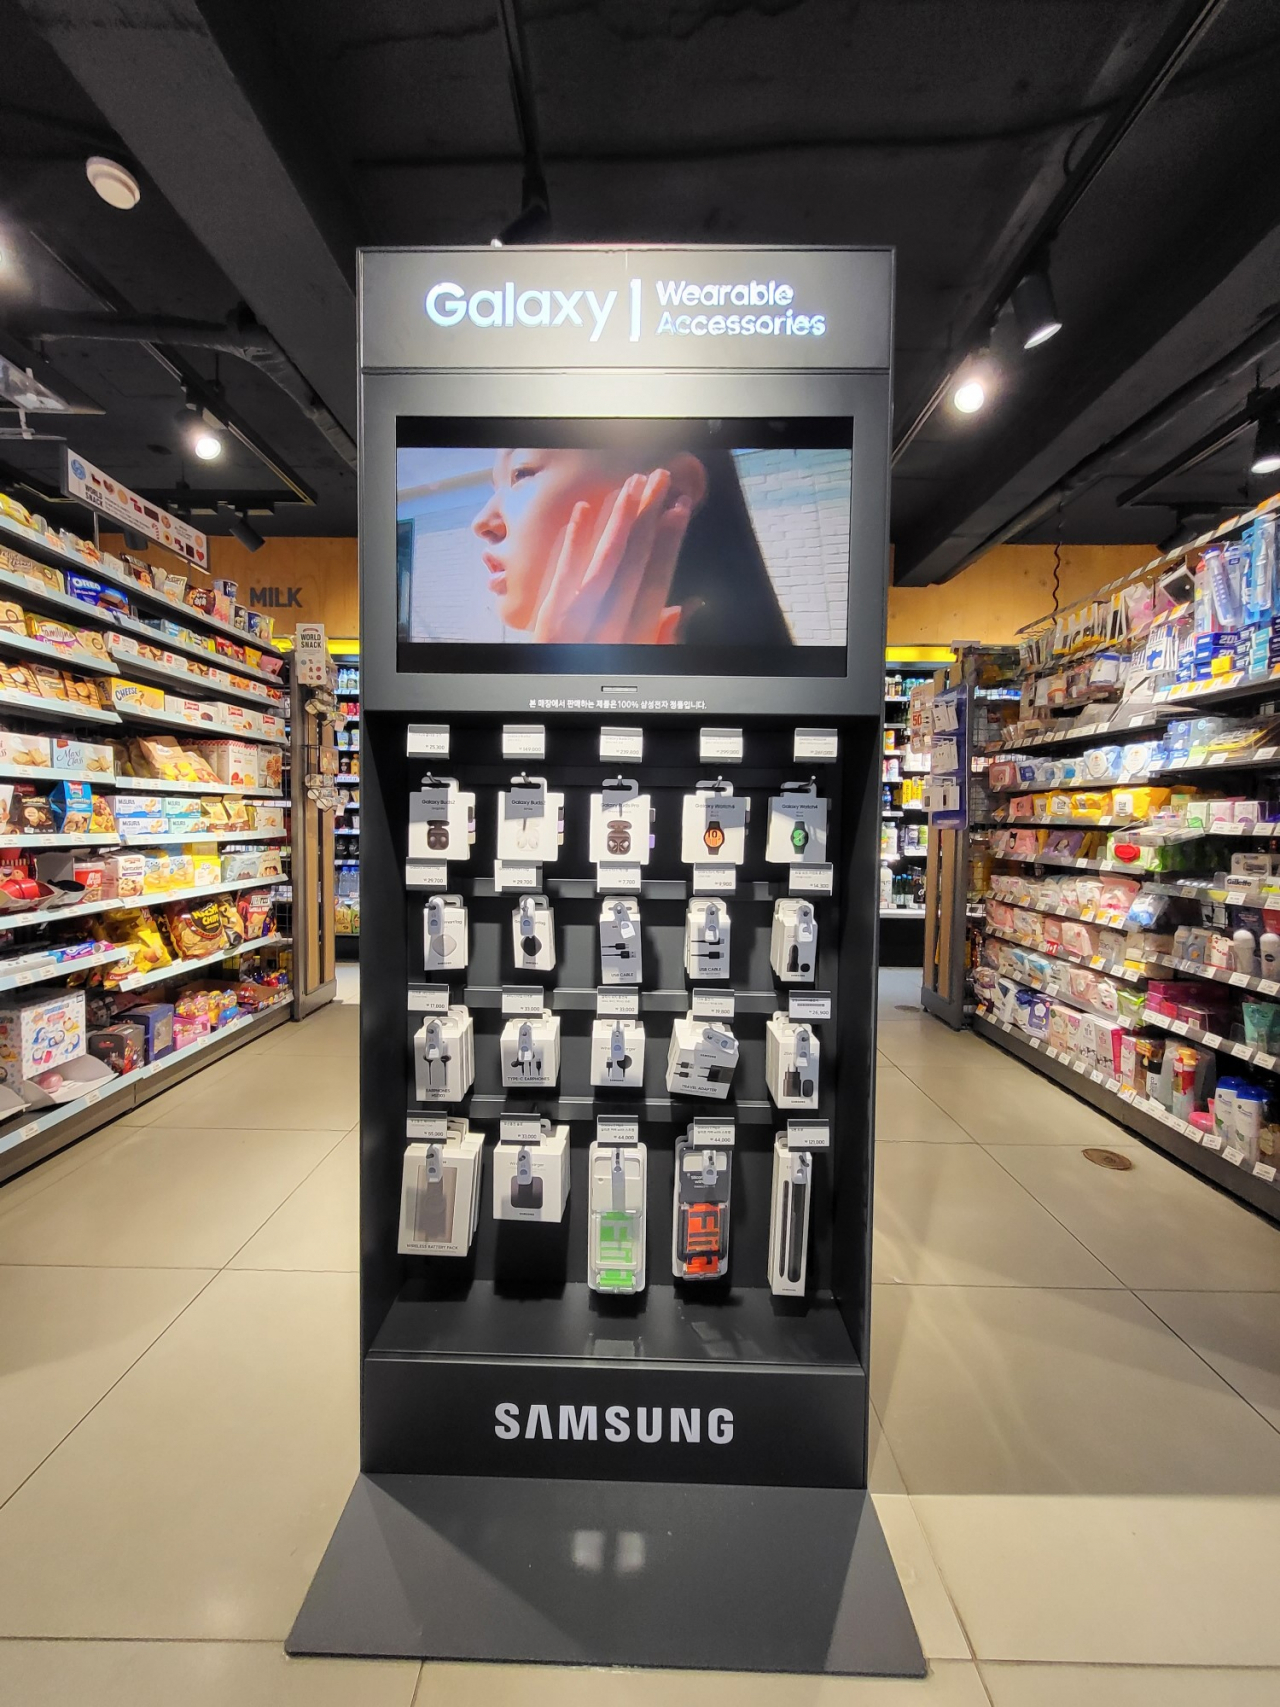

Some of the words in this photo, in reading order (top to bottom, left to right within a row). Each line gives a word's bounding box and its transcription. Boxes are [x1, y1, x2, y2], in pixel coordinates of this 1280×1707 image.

[655, 280, 794, 306] Wearable
[425, 282, 618, 343] Galaxy
[655, 308, 827, 337] Accessories
[85, 484, 103, 500] WORLD
[85, 492, 103, 507] SNACK
[72, 577, 101, 591] OREO
[250, 587, 303, 608] MILK
[115, 687, 137, 701] CHEESE
[529, 700, 536, 708] 본
[537, 700, 565, 709] 매장에서
[567, 700, 595, 709] 판매하는
[640, 701, 668, 709] 삼성전자
[670, 701, 707, 710] 정품입니다.
[912, 714, 922, 726] 50
[57, 748, 81, 761] Maxi
[67, 756, 84, 767] Class
[1227, 878, 1252, 887] Gillette
[495, 1402, 734, 1445] SAMSUNG
